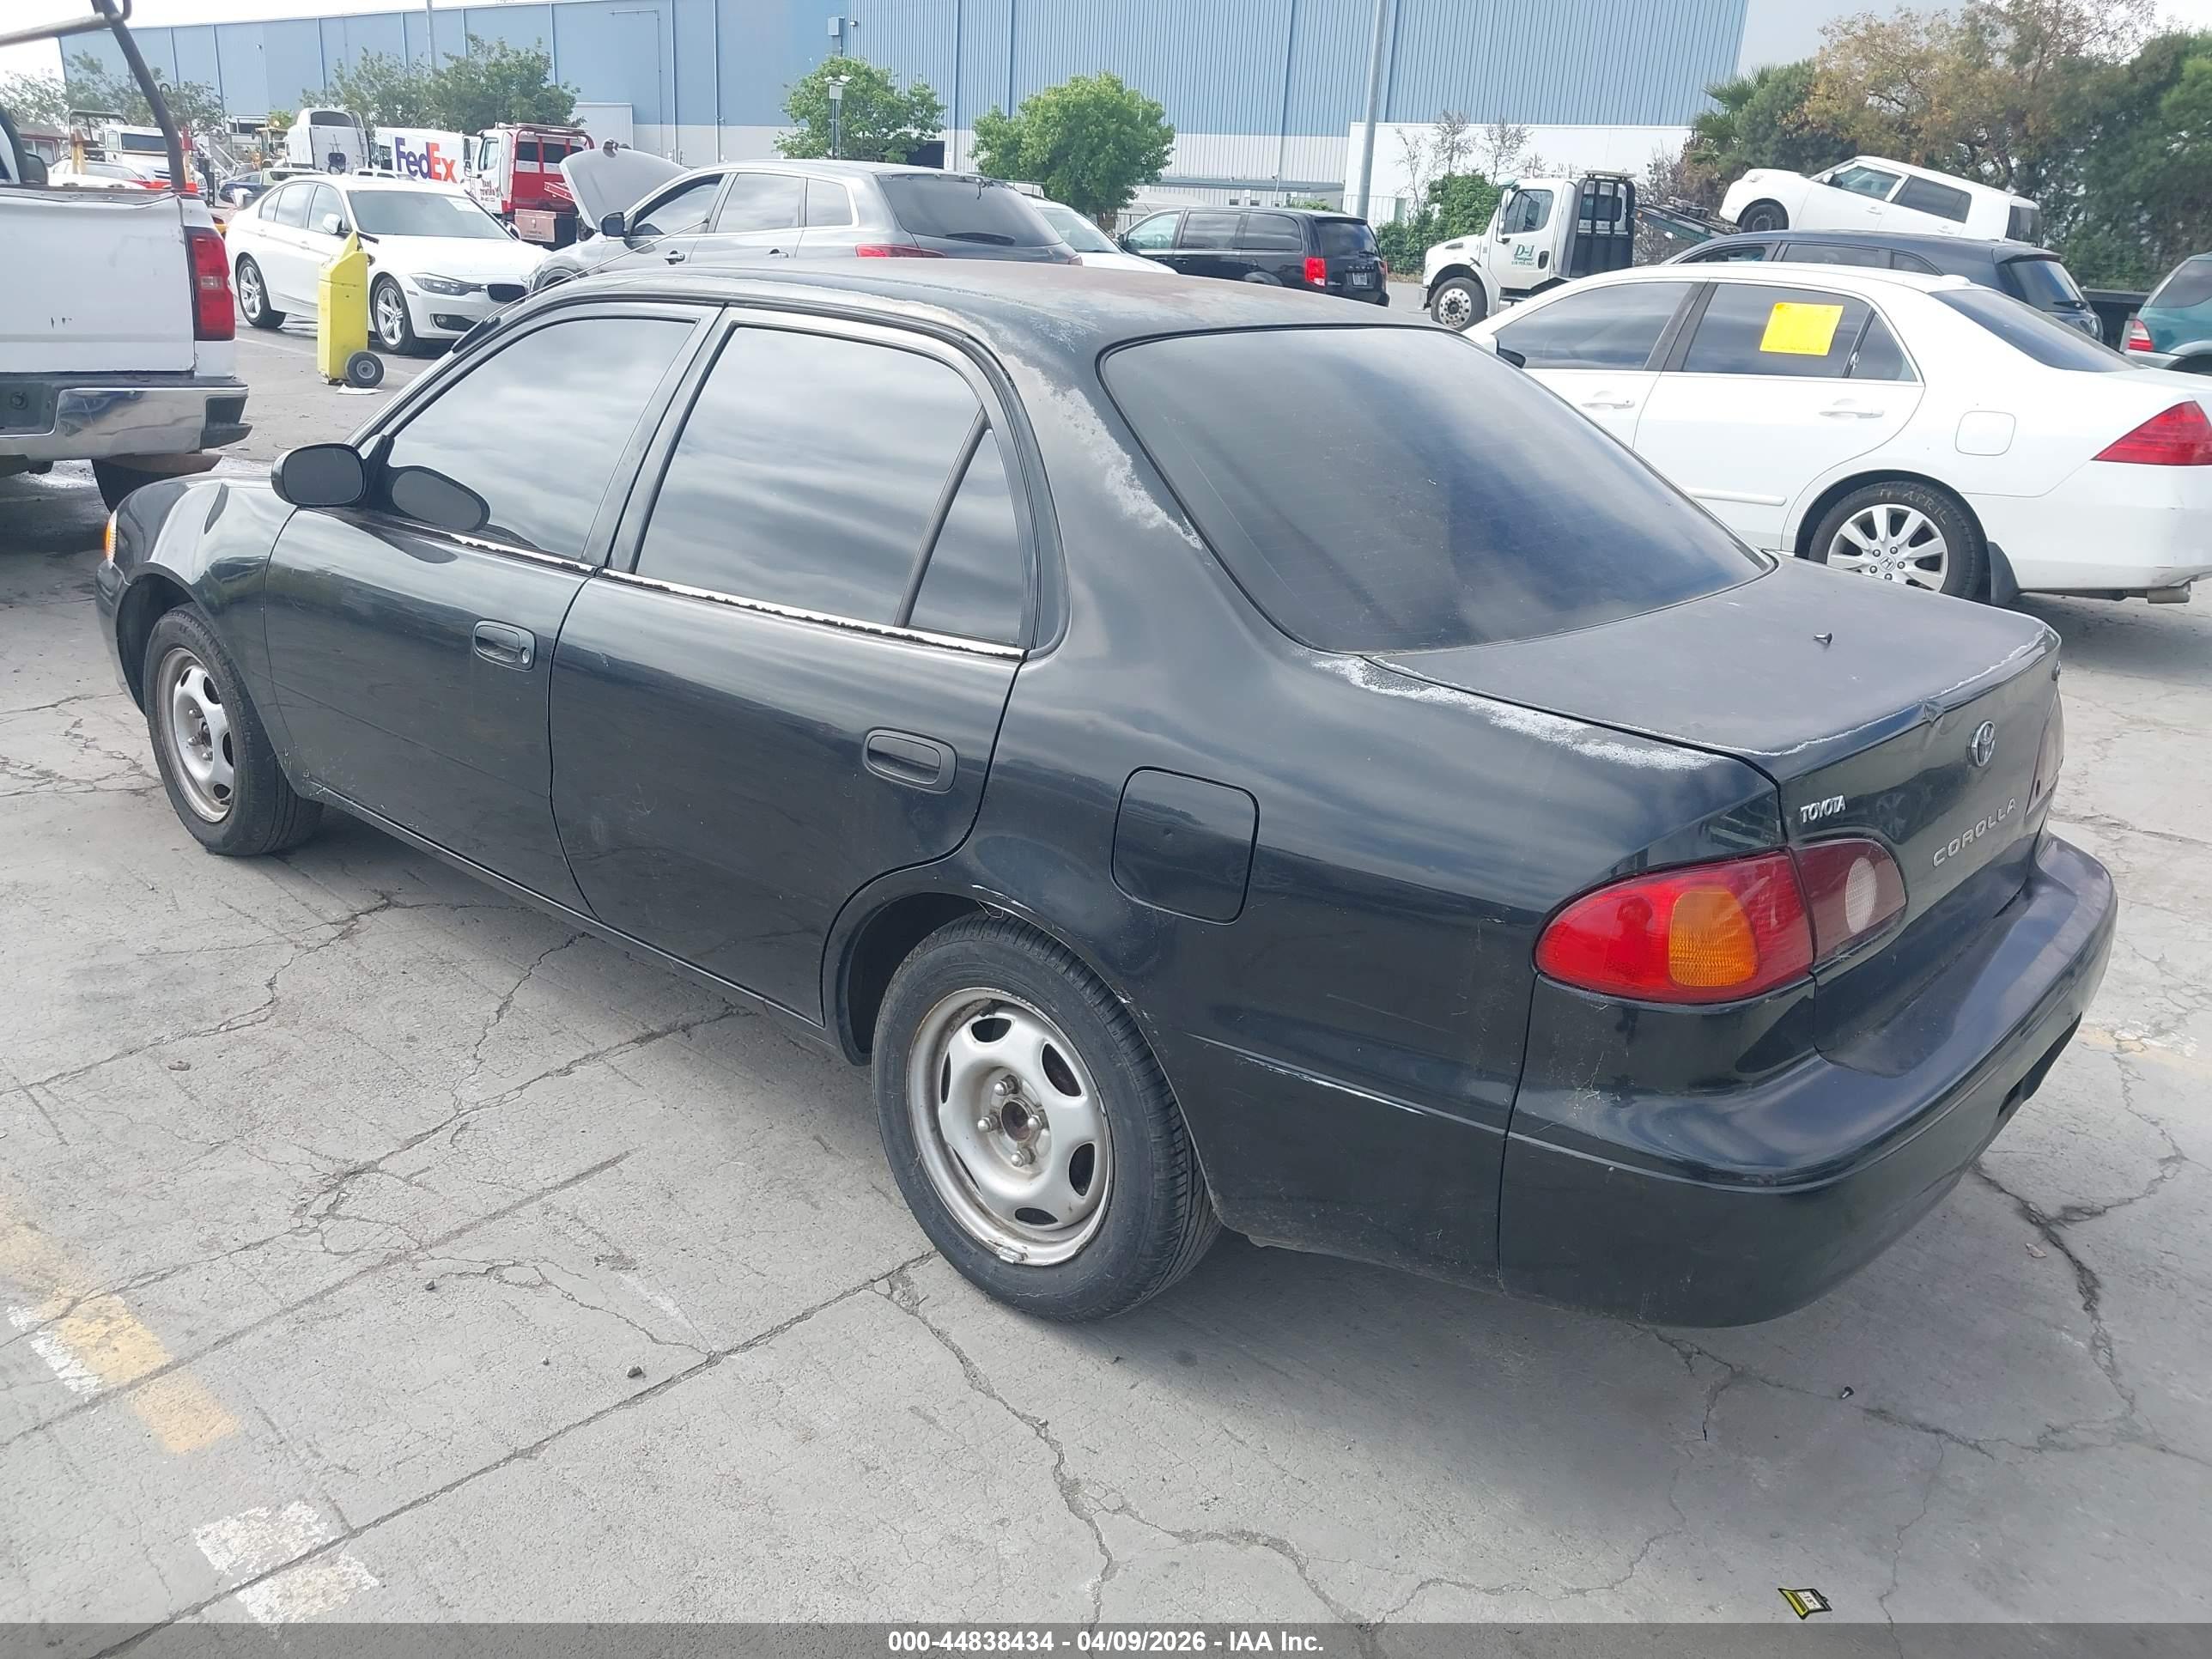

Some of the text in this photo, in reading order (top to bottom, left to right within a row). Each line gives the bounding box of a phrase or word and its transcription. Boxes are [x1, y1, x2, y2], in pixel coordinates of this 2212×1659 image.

[395, 137, 457, 184] FedEx
[1903, 490, 1947, 526] APRIL
[1800, 795, 1845, 823] TOYOTA
[1933, 798, 2017, 867] COROLLA
